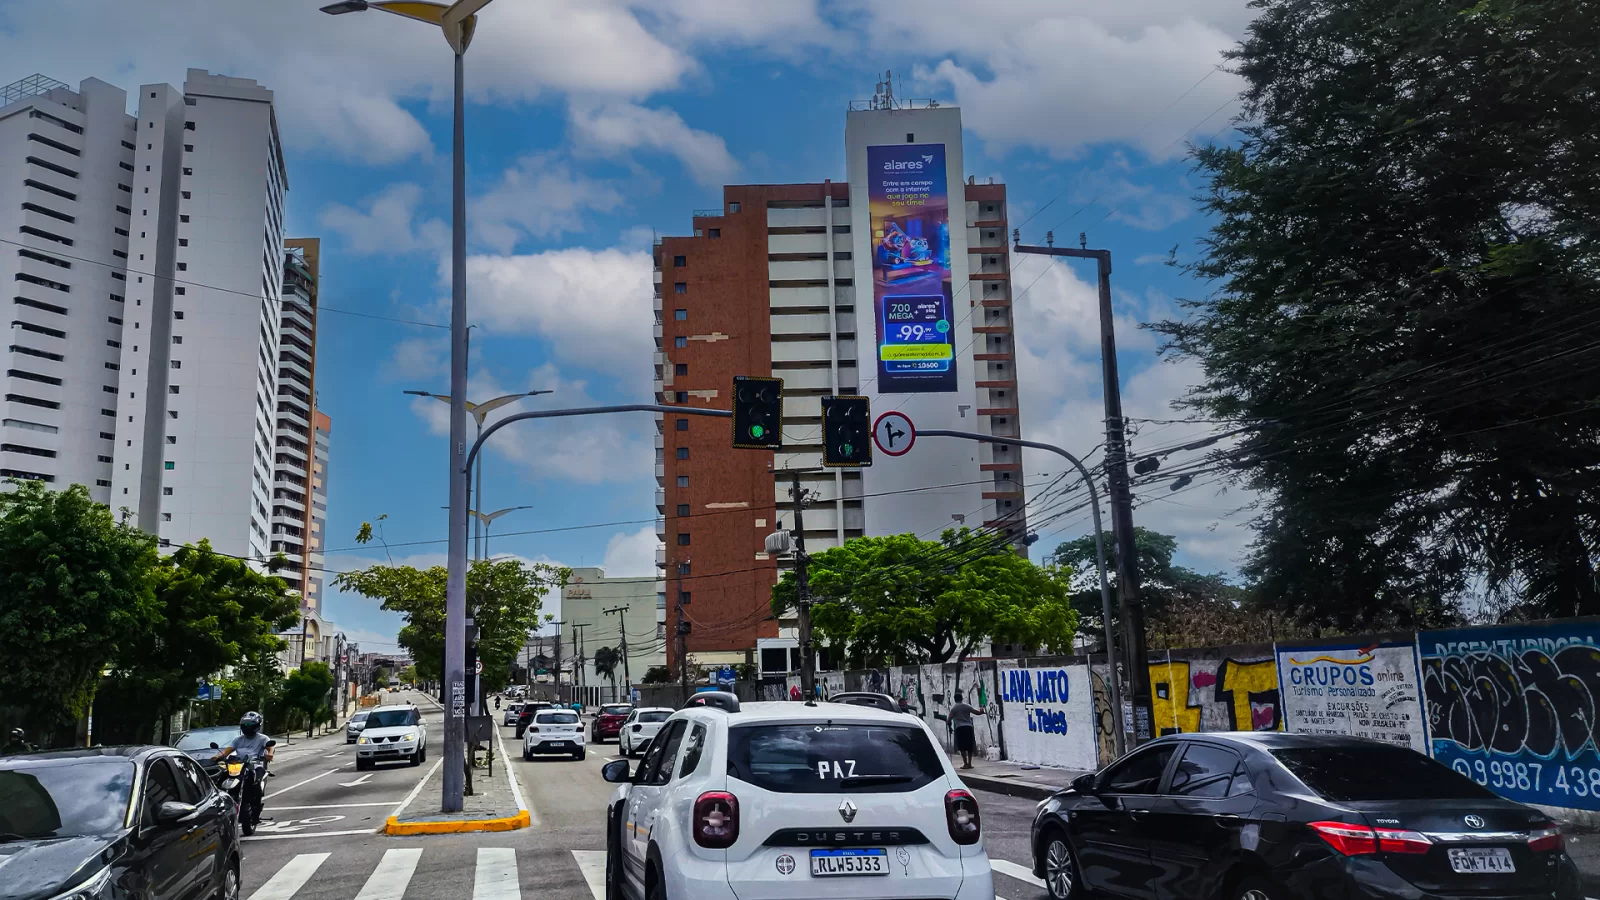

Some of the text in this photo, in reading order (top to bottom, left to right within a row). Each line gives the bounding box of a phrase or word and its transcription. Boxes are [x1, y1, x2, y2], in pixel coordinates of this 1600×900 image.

[883, 160, 923, 170] alares
[891, 303, 911, 313] 700
[1291, 666, 1405, 685] GRUPOS online
[1001, 669, 1069, 704] LAVA JATO
[1292, 686, 1376, 697] Turismo Personalizado
[1327, 701, 1369, 712] EXCURSÕES
[1035, 709, 1067, 736] Teles
[817, 760, 859, 780] PAZ
[797, 832, 901, 841] DUSTER
[819, 856, 881, 873] RLW5J33
